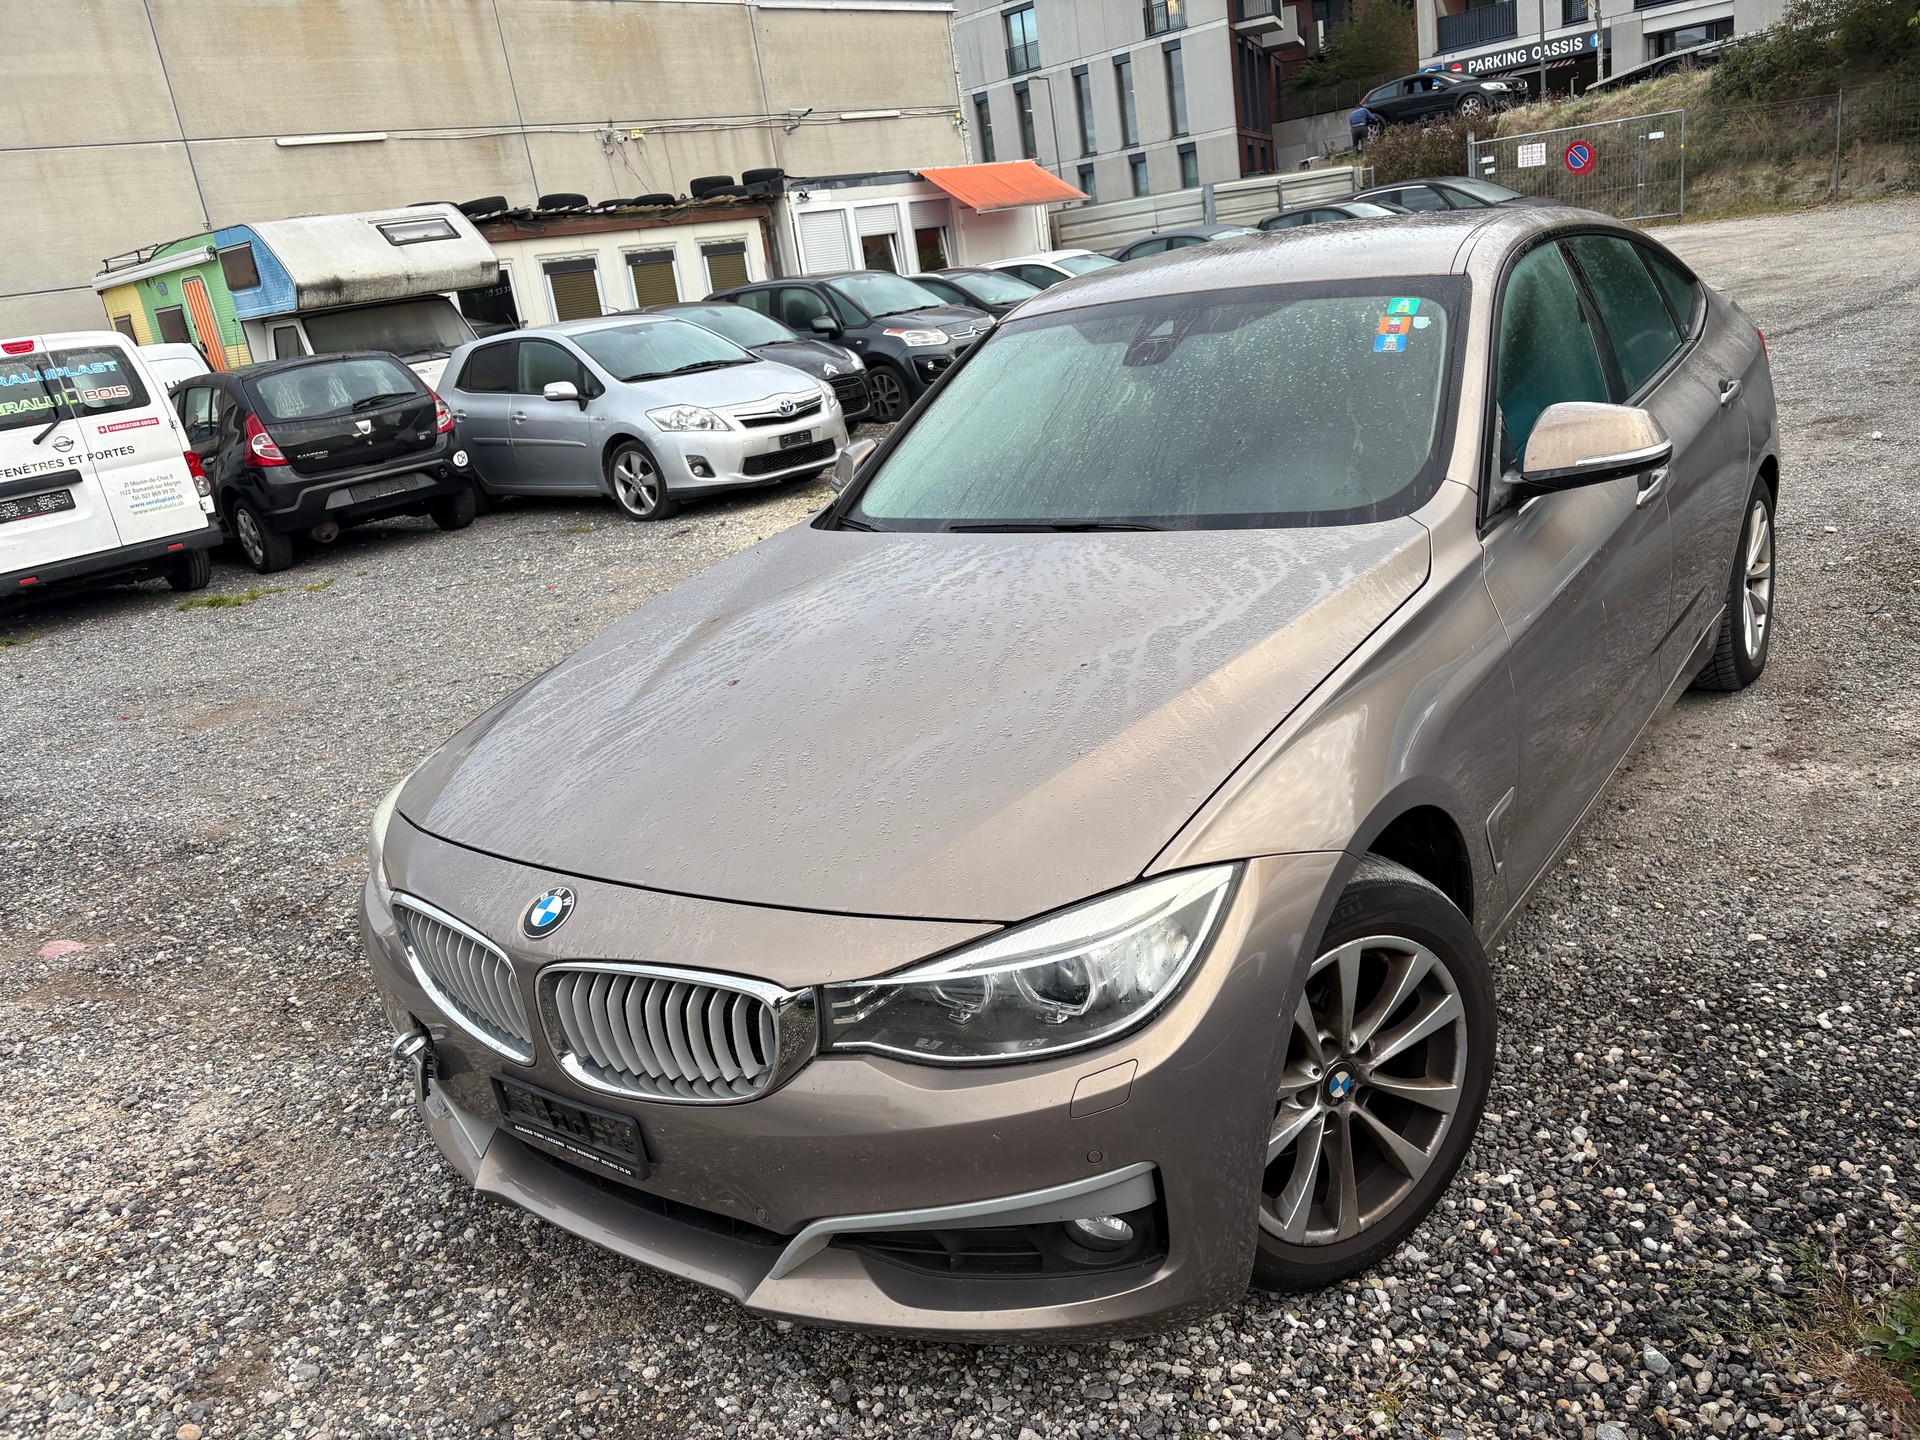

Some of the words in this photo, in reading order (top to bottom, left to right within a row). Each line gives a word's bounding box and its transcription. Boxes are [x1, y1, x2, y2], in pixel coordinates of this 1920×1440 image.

[1468, 49, 1527, 73] PARKING
[83, 385, 131, 402] BOIS
[109, 420, 140, 431] FABRICATION
[140, 418, 158, 426] SUISSE
[0, 458, 65, 479] FENÊTRES
[68, 454, 83, 465] ET
[87, 445, 135, 462] PORTES
[456, 452, 467, 465] CH
[129, 494, 183, 509] www.veraluplast.ch
[514, 1125, 533, 1135] GARAGE
[544, 1135, 565, 1147] LAZZARO
